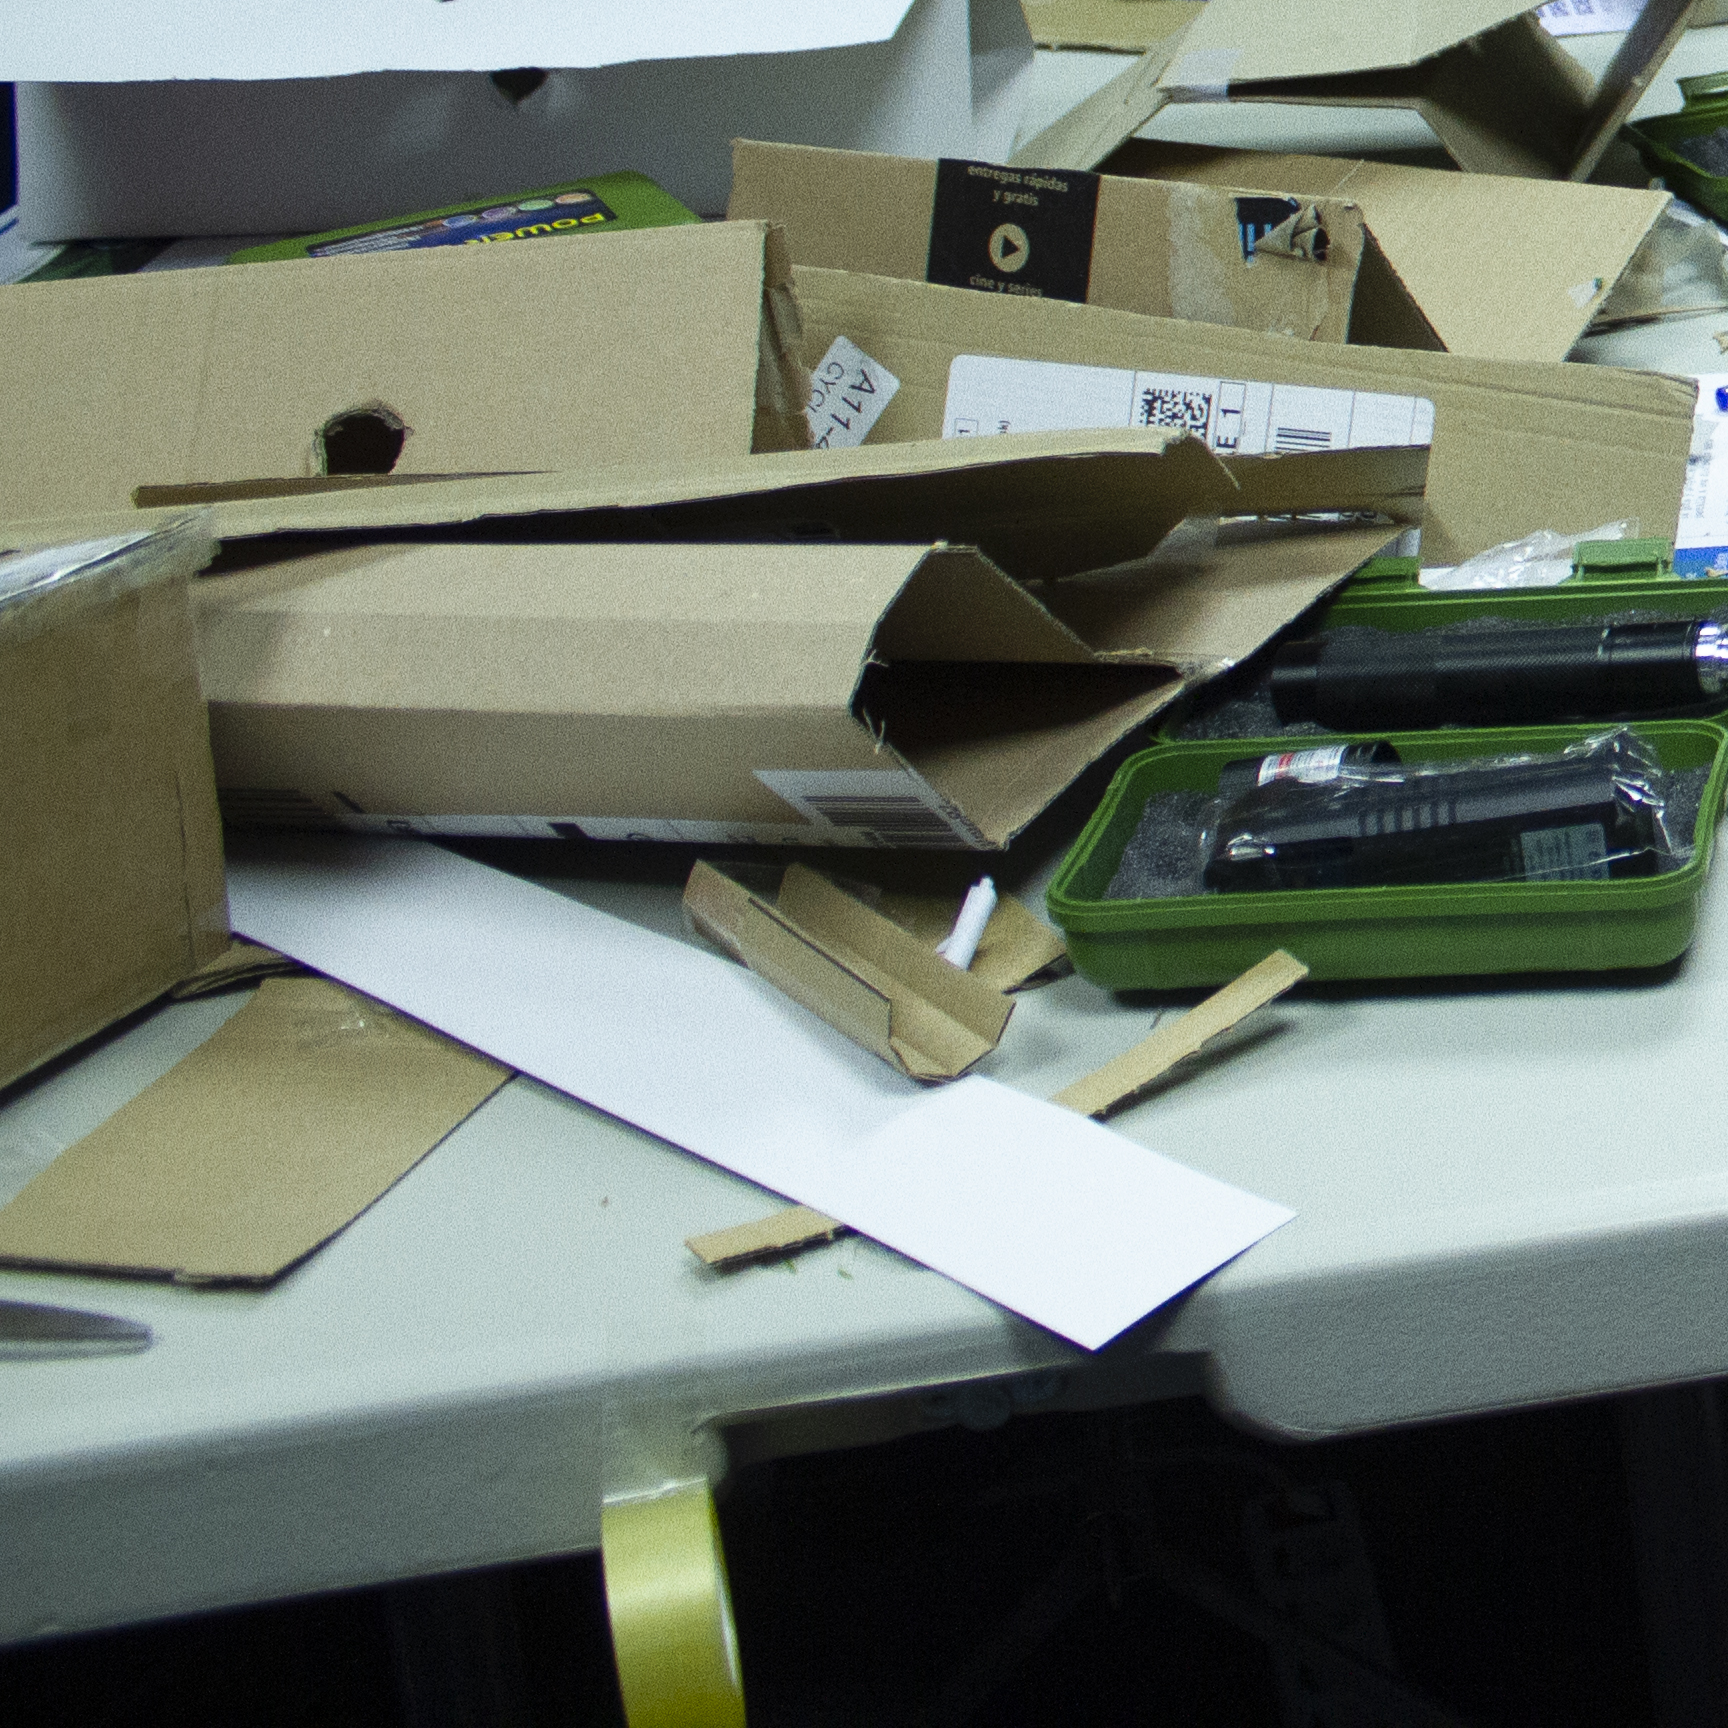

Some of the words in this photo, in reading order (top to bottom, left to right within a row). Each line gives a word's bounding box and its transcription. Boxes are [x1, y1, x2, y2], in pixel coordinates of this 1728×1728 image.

[967, 164, 1022, 186] entregas
[1023, 171, 1069, 193] rápidas
[992, 189, 1001, 203] y
[1002, 190, 1039, 207] gratis
[969, 273, 995, 289] cine
[998, 279, 1007, 293] y
[1007, 280, 1044, 298] series
